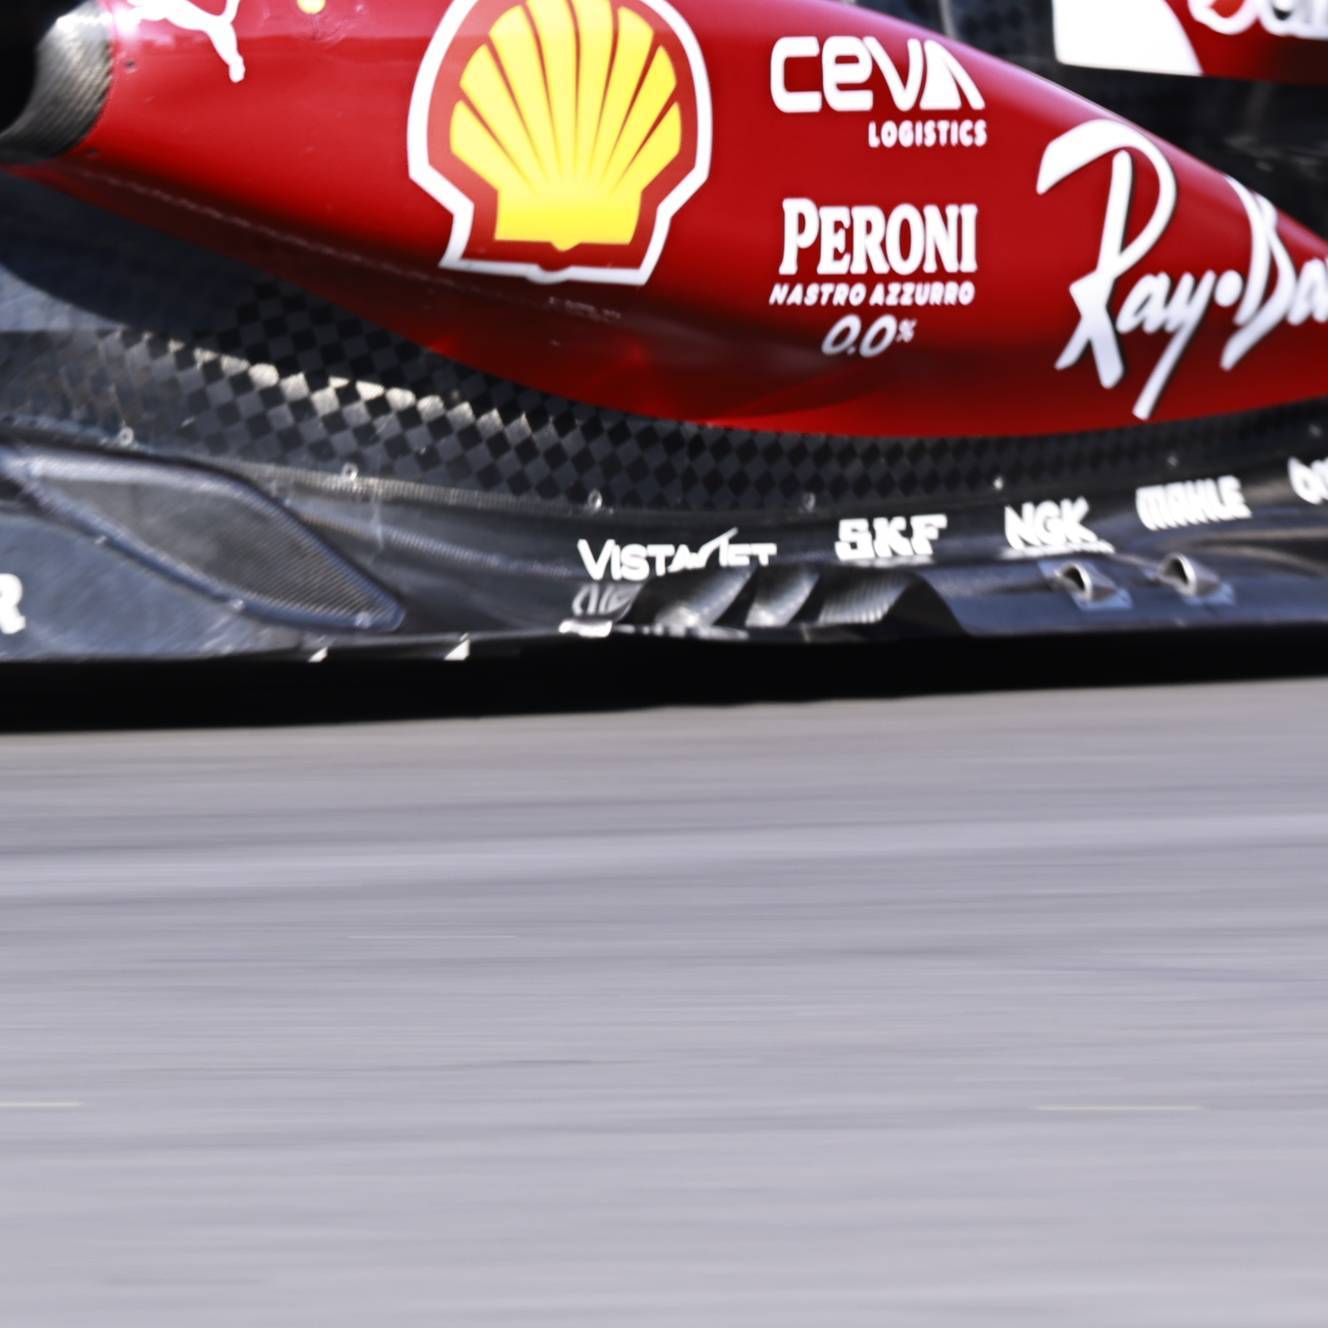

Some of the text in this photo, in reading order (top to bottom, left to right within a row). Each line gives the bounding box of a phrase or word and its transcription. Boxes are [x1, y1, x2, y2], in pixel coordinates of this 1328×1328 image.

[868, 120, 987, 147] LOGISTICS
[778, 196, 978, 277] PERONI
[768, 280, 976, 307] NASTRO AZZURRO
[834, 514, 948, 561] SKF
[1003, 496, 1100, 551] NGK
